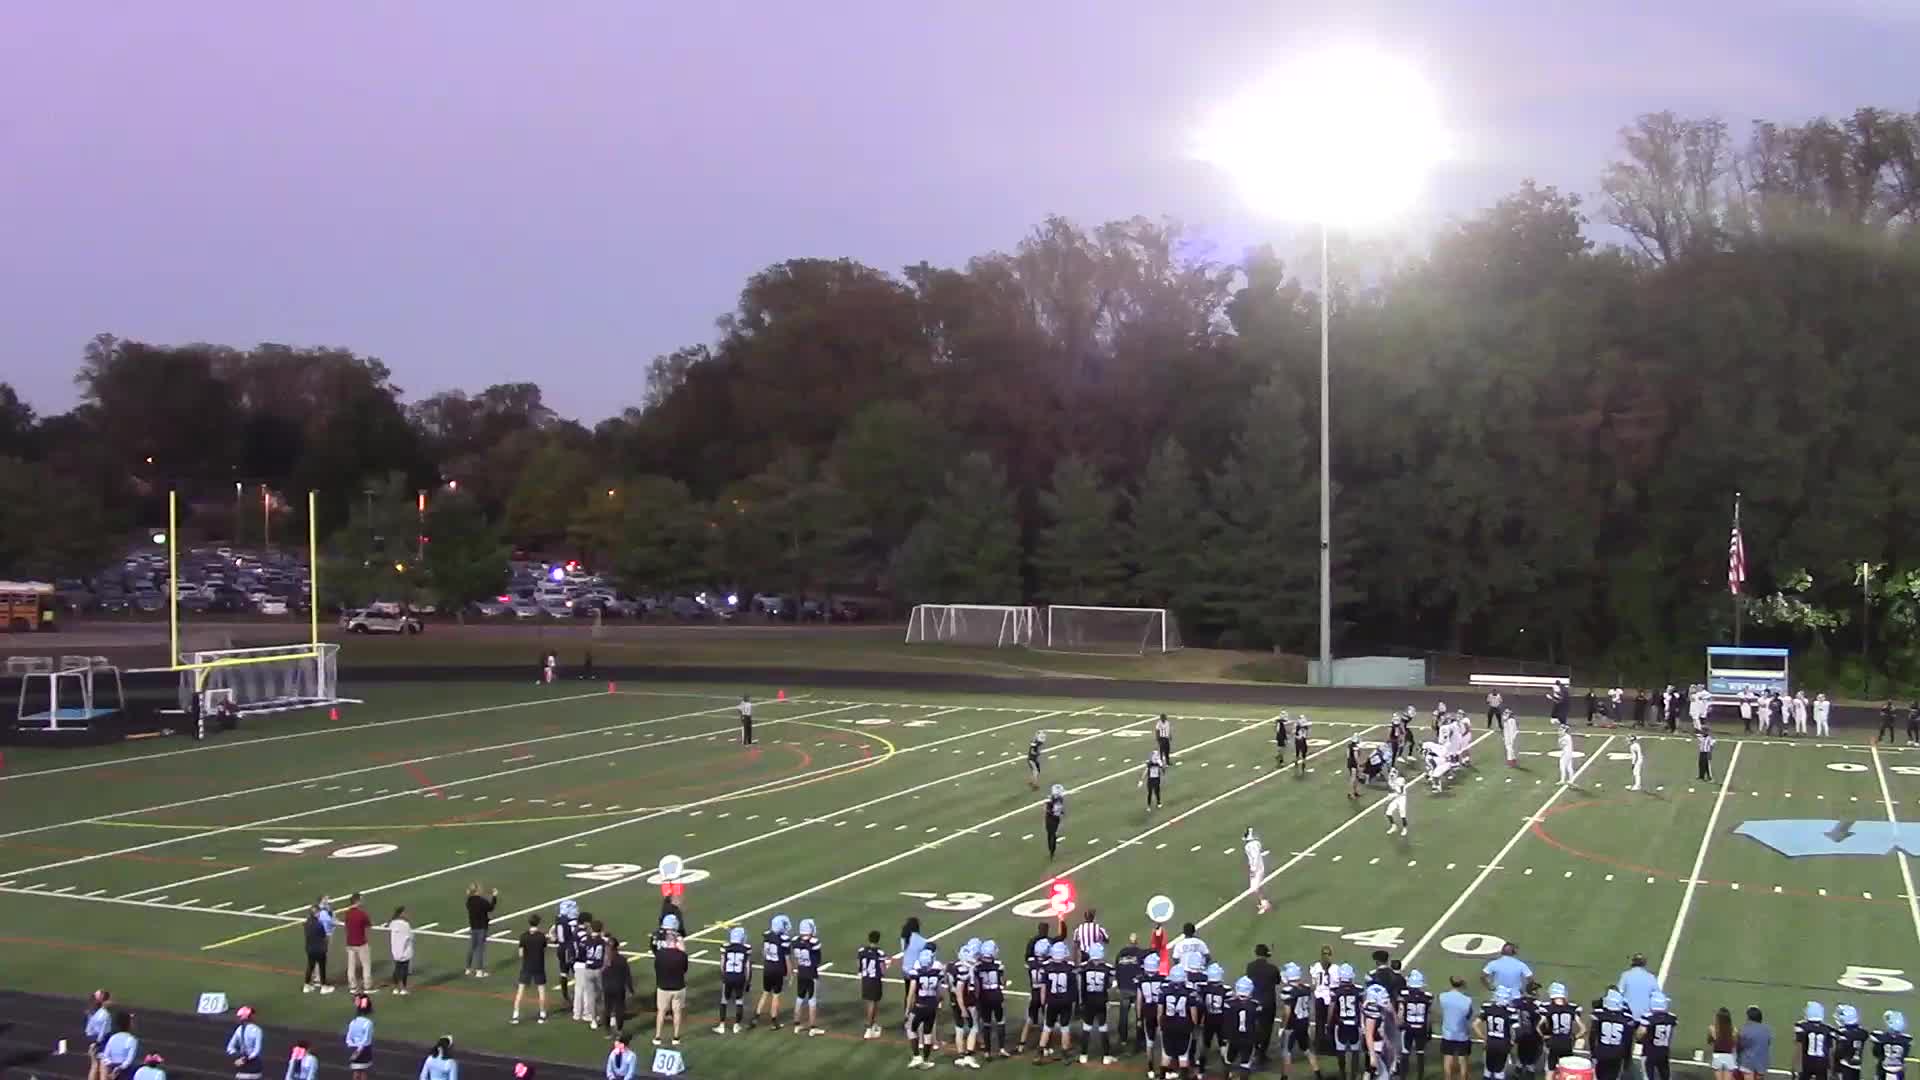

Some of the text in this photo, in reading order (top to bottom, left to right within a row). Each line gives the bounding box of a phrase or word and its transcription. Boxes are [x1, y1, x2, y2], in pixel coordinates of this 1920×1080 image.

[263, 838, 399, 857] 10
[1052, 883, 1069, 912] 2
[1340, 927, 1507, 955] 40
[860, 957, 877, 978] 14
[203, 997, 218, 1010] 20
[1338, 995, 1356, 1017] 15
[1239, 1010, 1247, 1032] 1
[1600, 1022, 1624, 1045] 95
[1653, 1025, 1671, 1046] 51
[657, 1053, 675, 1071] 30
